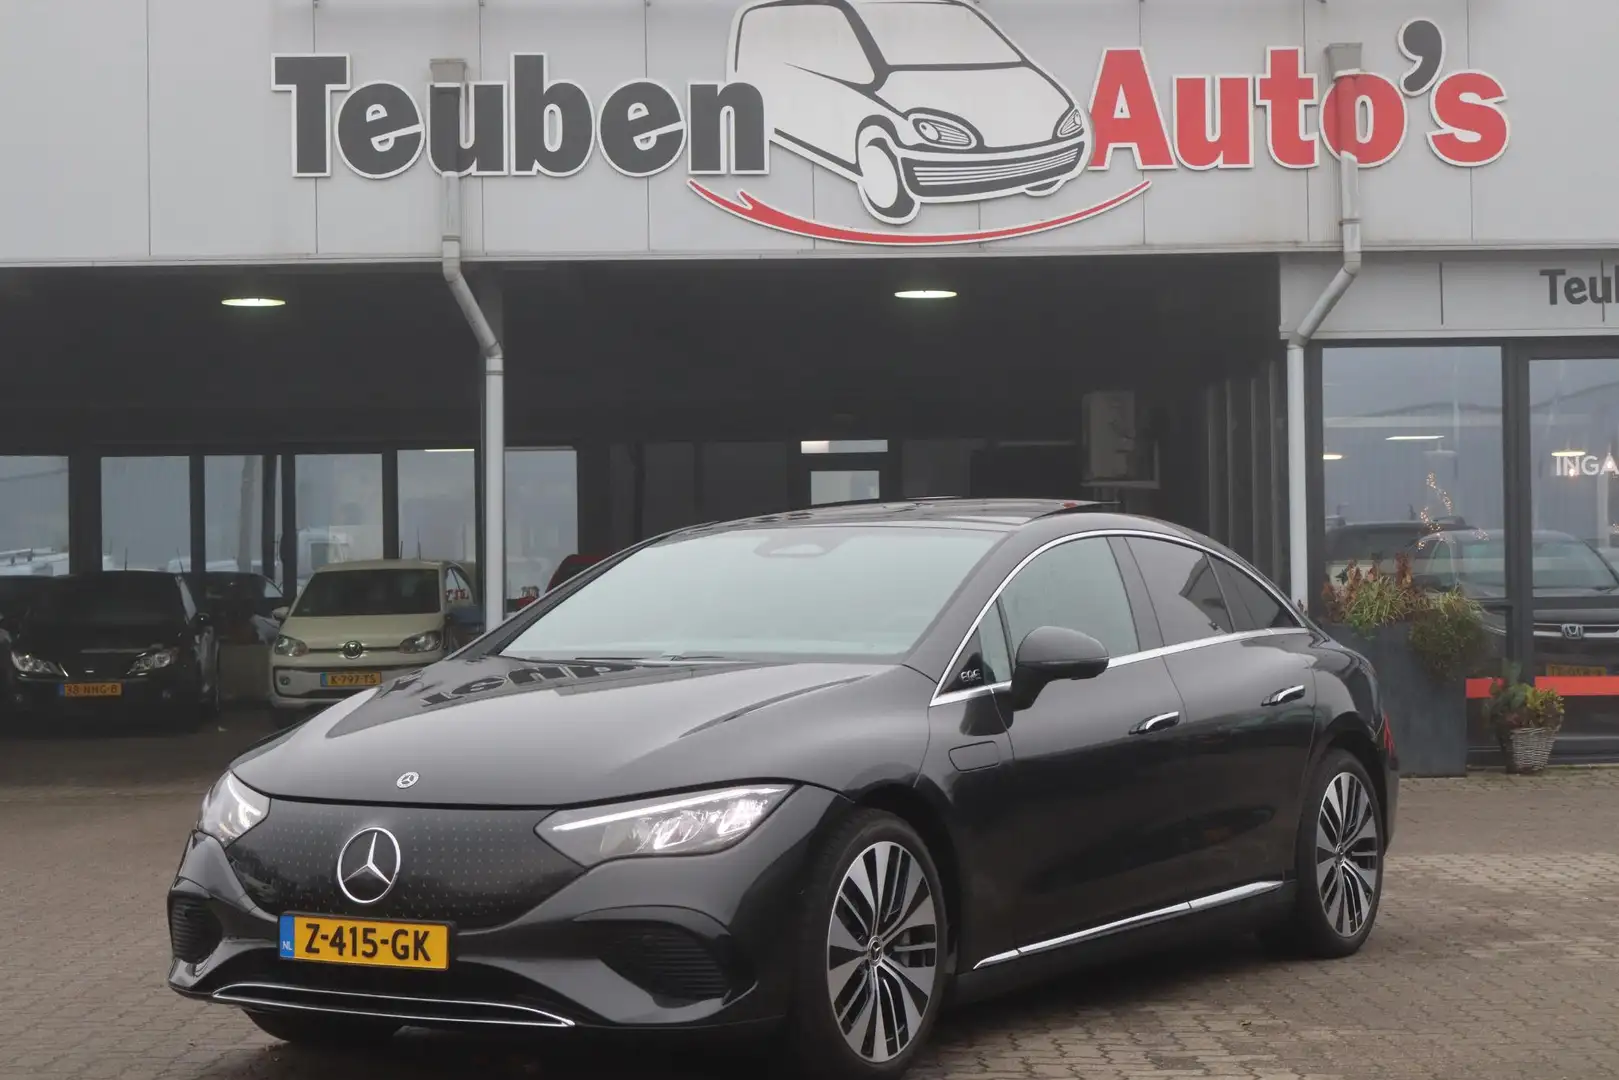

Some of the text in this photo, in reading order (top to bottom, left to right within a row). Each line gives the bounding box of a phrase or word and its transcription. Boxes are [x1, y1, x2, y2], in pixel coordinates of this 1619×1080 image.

[271, 17, 1510, 179] Teuben Auto's
[1539, 265, 1619, 305] Teu
[281, 922, 432, 962] NL Z-415-GK
